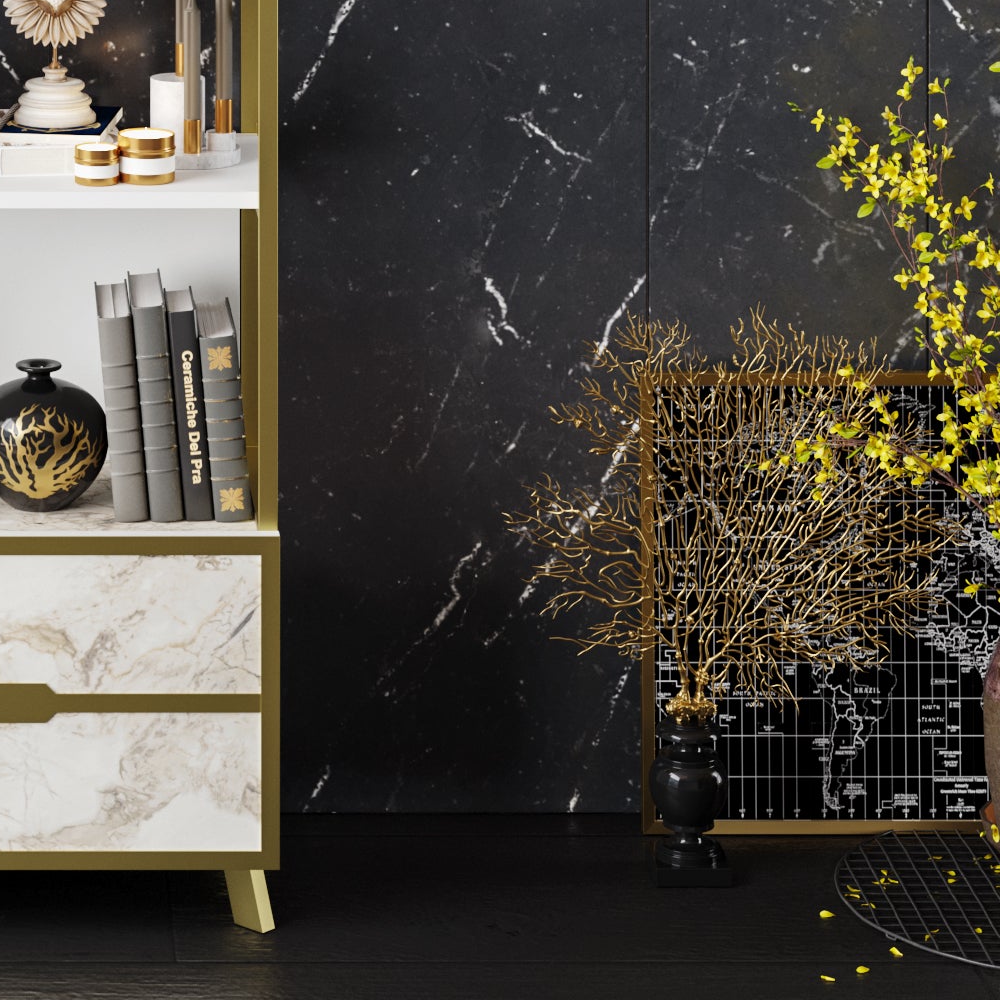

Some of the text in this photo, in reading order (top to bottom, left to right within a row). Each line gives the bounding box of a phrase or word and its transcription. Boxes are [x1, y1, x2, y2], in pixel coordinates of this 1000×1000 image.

[182, 350, 203, 485] Ceramiche Del Pra
